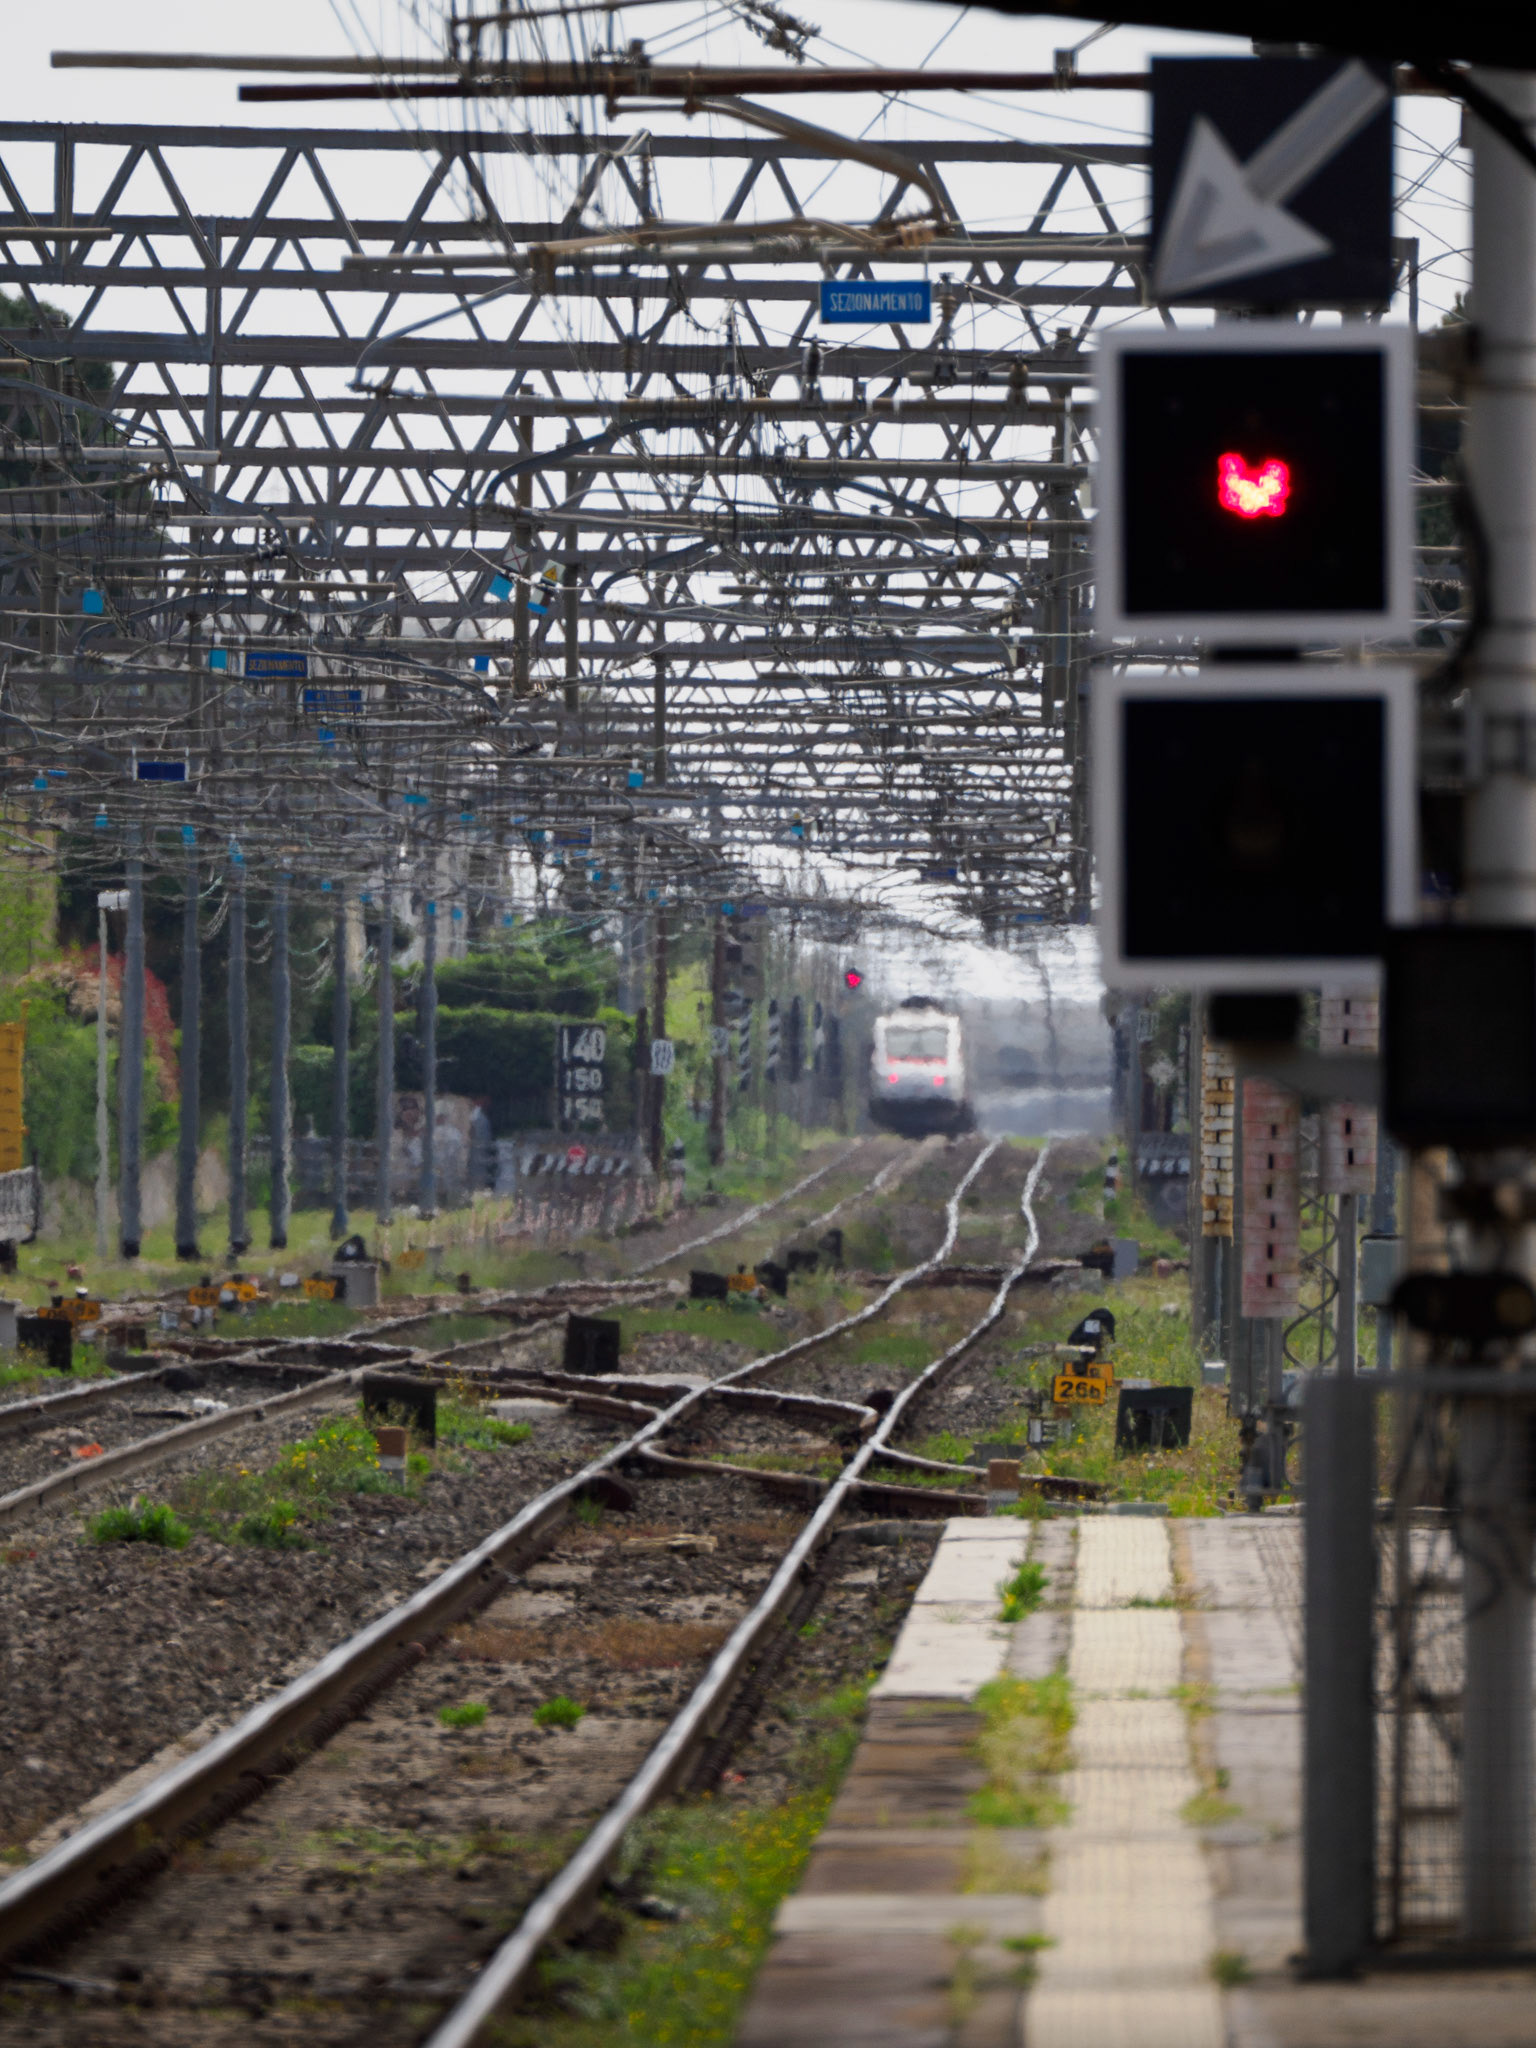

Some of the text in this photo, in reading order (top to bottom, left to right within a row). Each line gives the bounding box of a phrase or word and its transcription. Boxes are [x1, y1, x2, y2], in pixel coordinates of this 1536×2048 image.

[830, 292, 923, 312] SEZIONAMENTO
[562, 1027, 606, 1063] 140
[565, 1067, 602, 1092] 150
